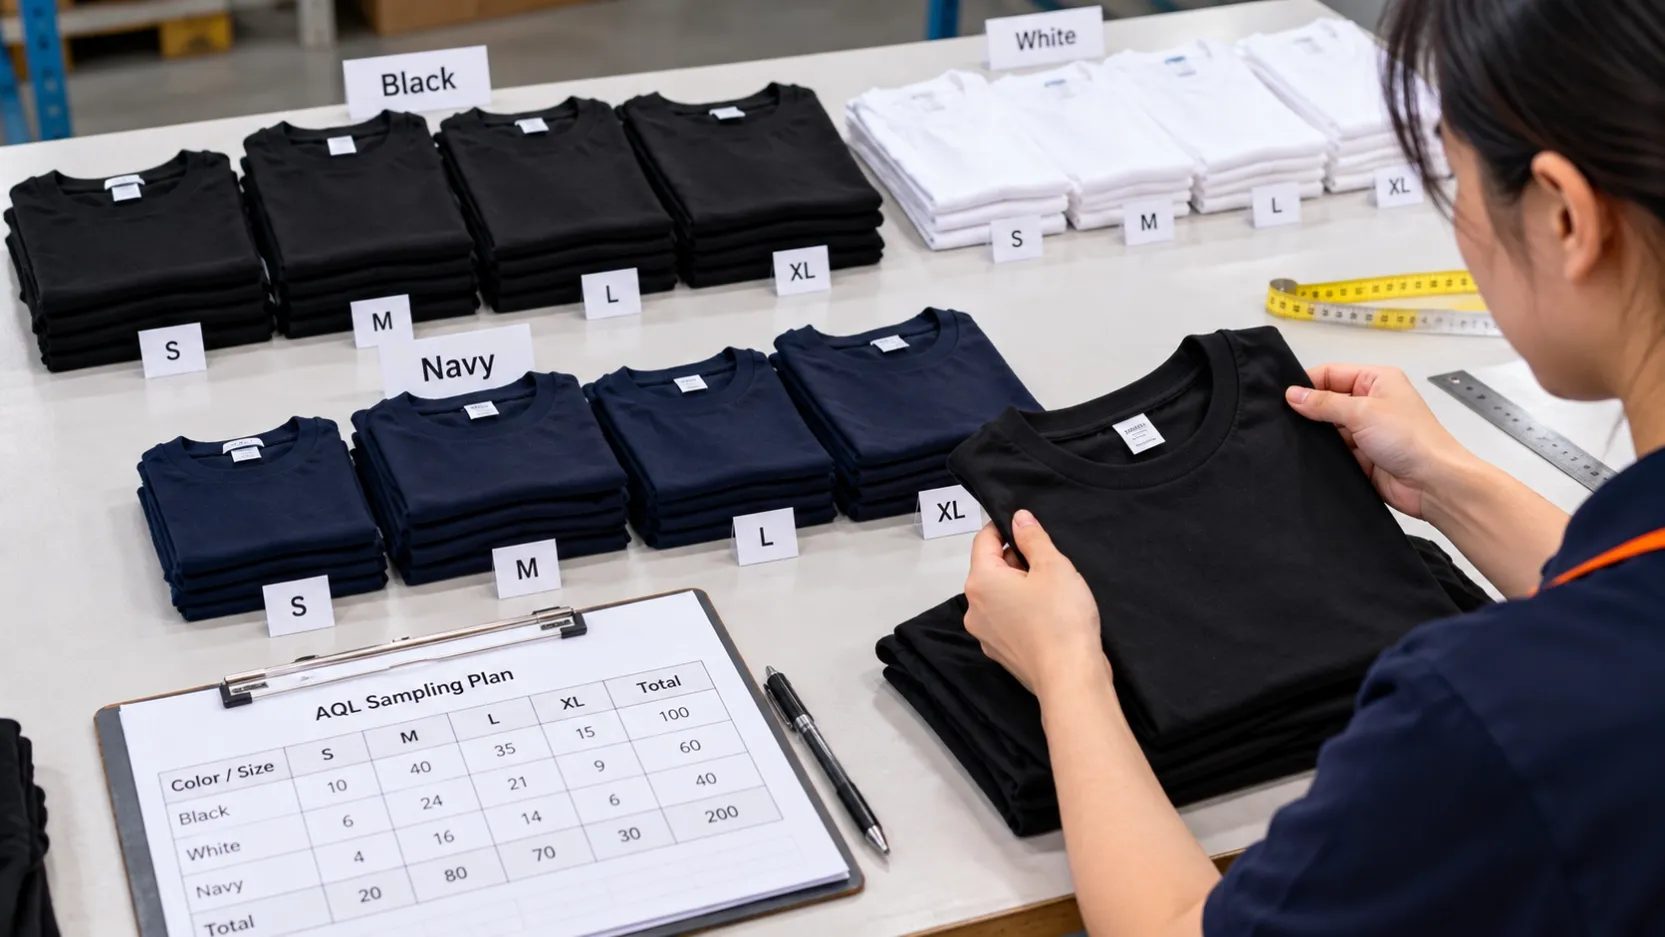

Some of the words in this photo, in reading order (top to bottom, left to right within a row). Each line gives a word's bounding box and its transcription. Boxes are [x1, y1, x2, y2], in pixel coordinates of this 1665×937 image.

[1015, 29, 1076, 51] White
[381, 66, 457, 97] Black
[1389, 177, 1410, 195] XL
[1271, 197, 1283, 214] L
[1140, 212, 1157, 231] M
[1011, 229, 1023, 248] S
[789, 261, 816, 282] XL
[605, 285, 619, 304] L
[372, 310, 393, 332] M
[165, 340, 181, 361] S
[421, 353, 495, 382] Navy
[936, 500, 966, 523] XL
[759, 526, 774, 547] L
[515, 557, 539, 580] M
[290, 595, 307, 617] S
[315, 700, 362, 721] AQL
[365, 680, 464, 710] Sampling
[467, 670, 514, 688] Plan
[171, 774, 220, 792] Color
[237, 763, 274, 779] Size
[321, 748, 334, 761] S
[400, 729, 419, 744] M
[487, 713, 500, 725] L
[560, 696, 585, 711] XL
[635, 674, 682, 694] Total
[178, 805, 230, 826] Black
[327, 779, 348, 793] 10
[410, 761, 432, 774] 40
[494, 742, 516, 757] 35
[575, 725, 596, 740] 15
[659, 706, 690, 722] 100
[186, 842, 241, 861] White
[342, 815, 354, 828] 6
[420, 794, 443, 810] 24
[507, 776, 527, 791] 21
[593, 760, 605, 772] 9
[679, 739, 702, 753] 60
[196, 880, 243, 898] Navy
[354, 850, 365, 863] 4
[433, 830, 455, 845] 16
[522, 810, 542, 825] 14
[609, 793, 621, 806] 6
[695, 772, 717, 786] 40
[204, 914, 255, 937] Total
[358, 886, 382, 903] 20
[444, 866, 468, 883] 80
[531, 845, 556, 862] 70
[618, 827, 641, 842] 30
[705, 805, 739, 824] 200
